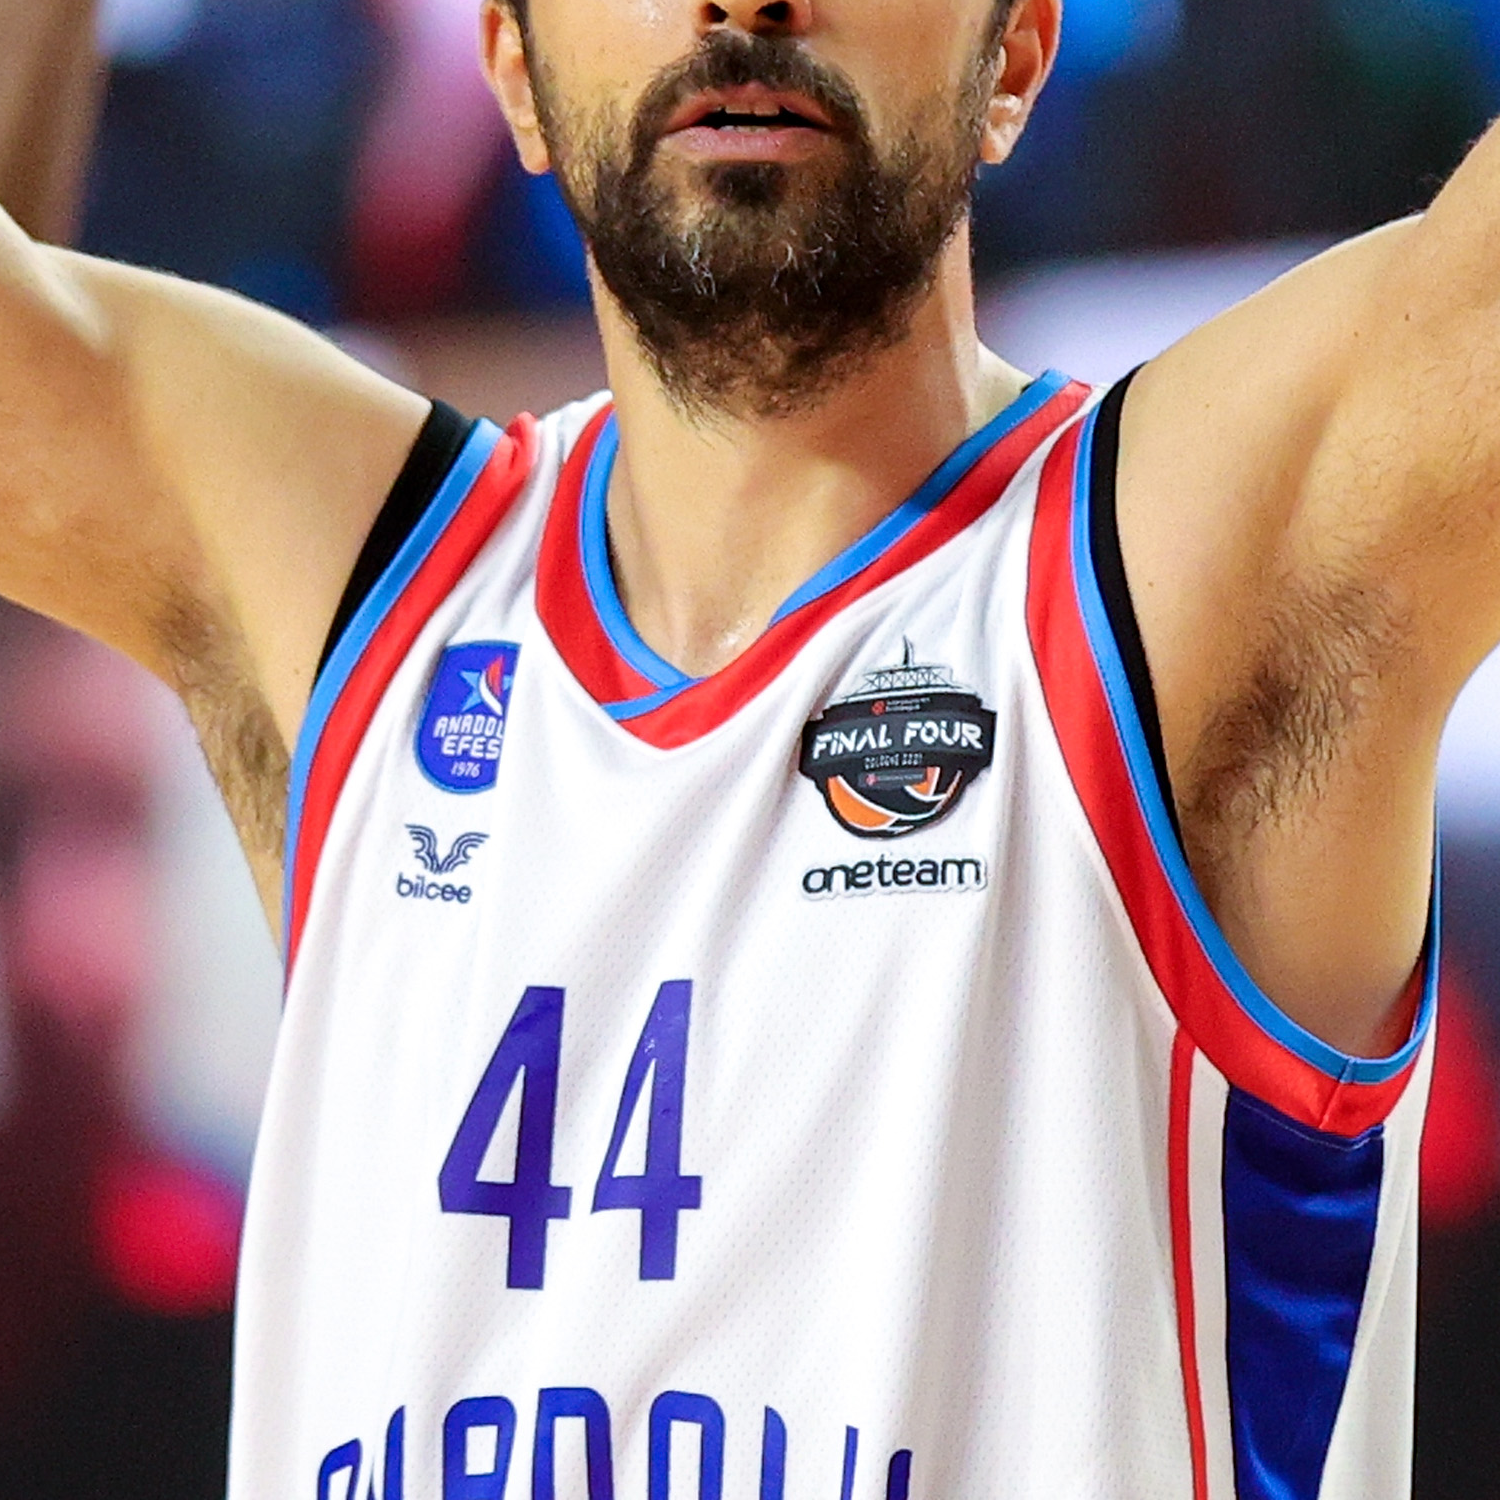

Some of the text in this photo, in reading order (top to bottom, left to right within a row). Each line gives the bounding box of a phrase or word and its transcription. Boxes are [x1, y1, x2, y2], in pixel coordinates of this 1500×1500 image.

[433, 713, 504, 740] ANADOL
[812, 719, 984, 760] FINAL FOUR
[442, 734, 502, 760] EFES
[450, 760, 481, 779] 1976
[396, 871, 472, 904] bilcee
[801, 853, 981, 894] oneteam
[437, 978, 703, 1291] 44
